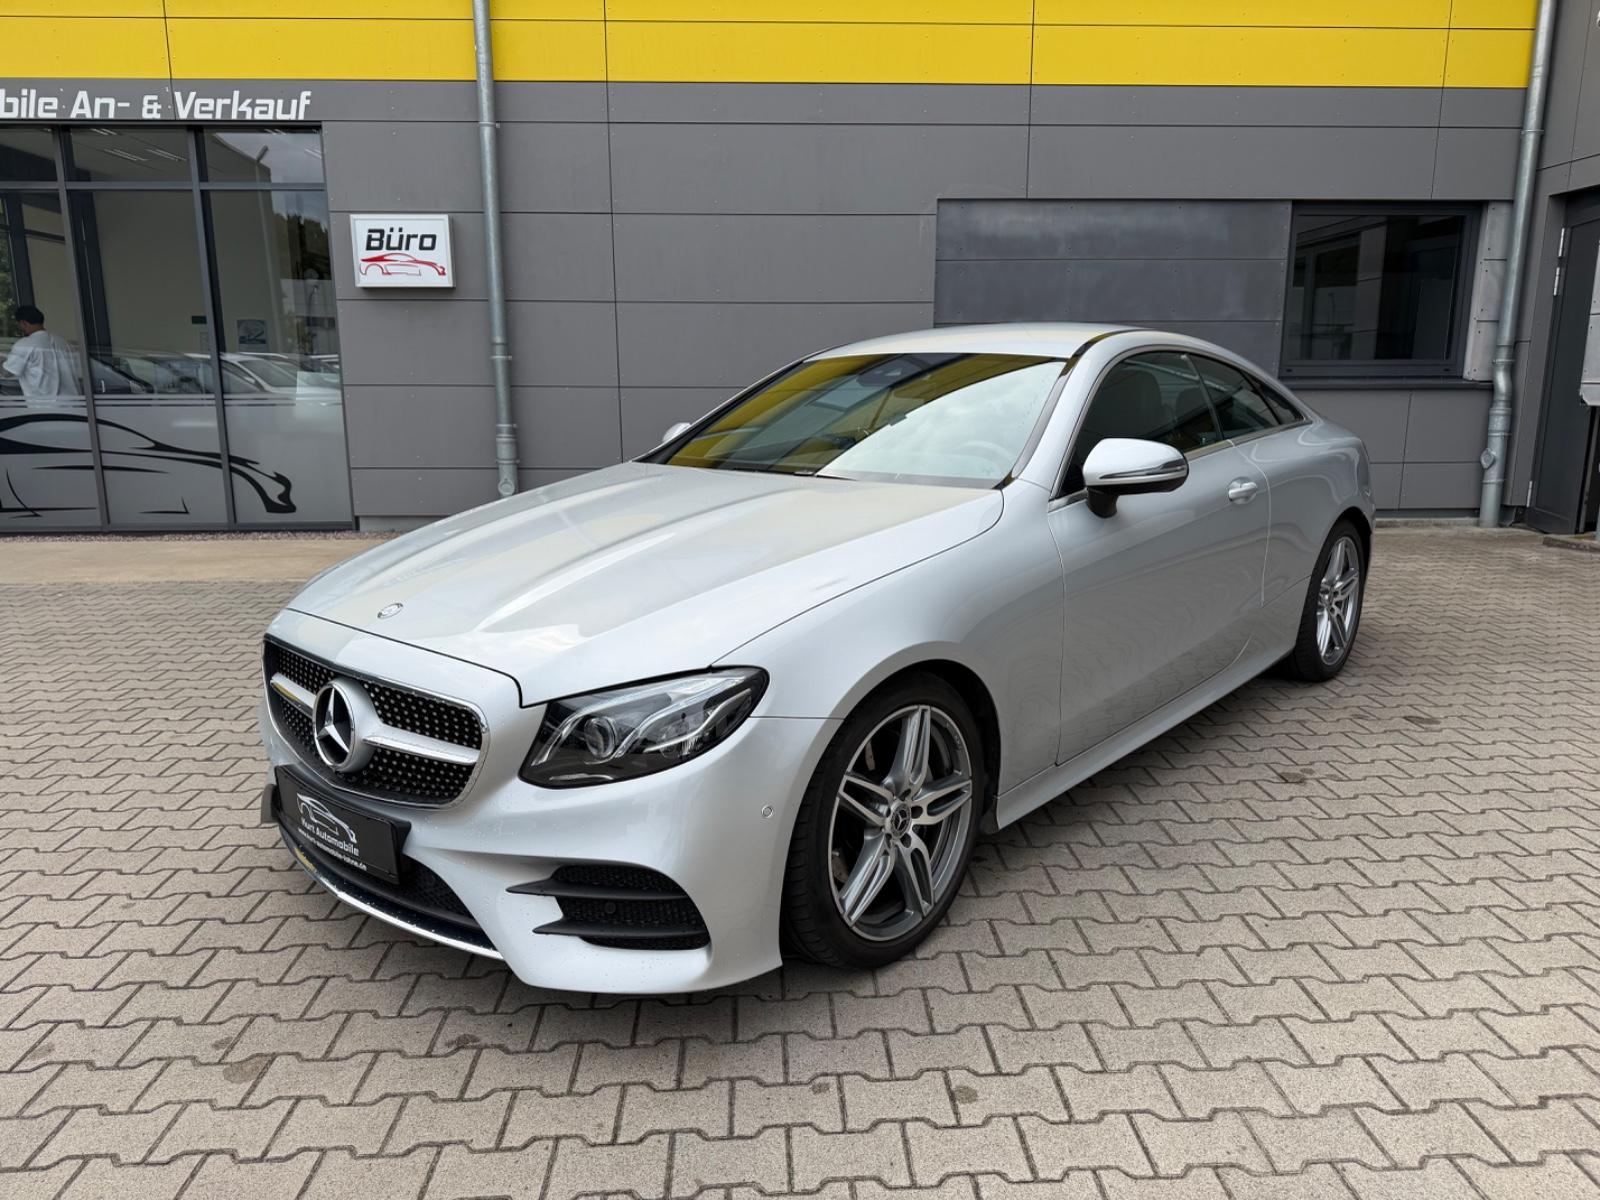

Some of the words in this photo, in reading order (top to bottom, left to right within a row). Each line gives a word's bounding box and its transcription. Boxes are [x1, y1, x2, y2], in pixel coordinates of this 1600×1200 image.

[0, 88, 58, 118] bile
[71, 90, 130, 119] An-
[142, 95, 162, 120] &
[175, 90, 312, 120] Verkauf
[365, 227, 437, 250] Büro
